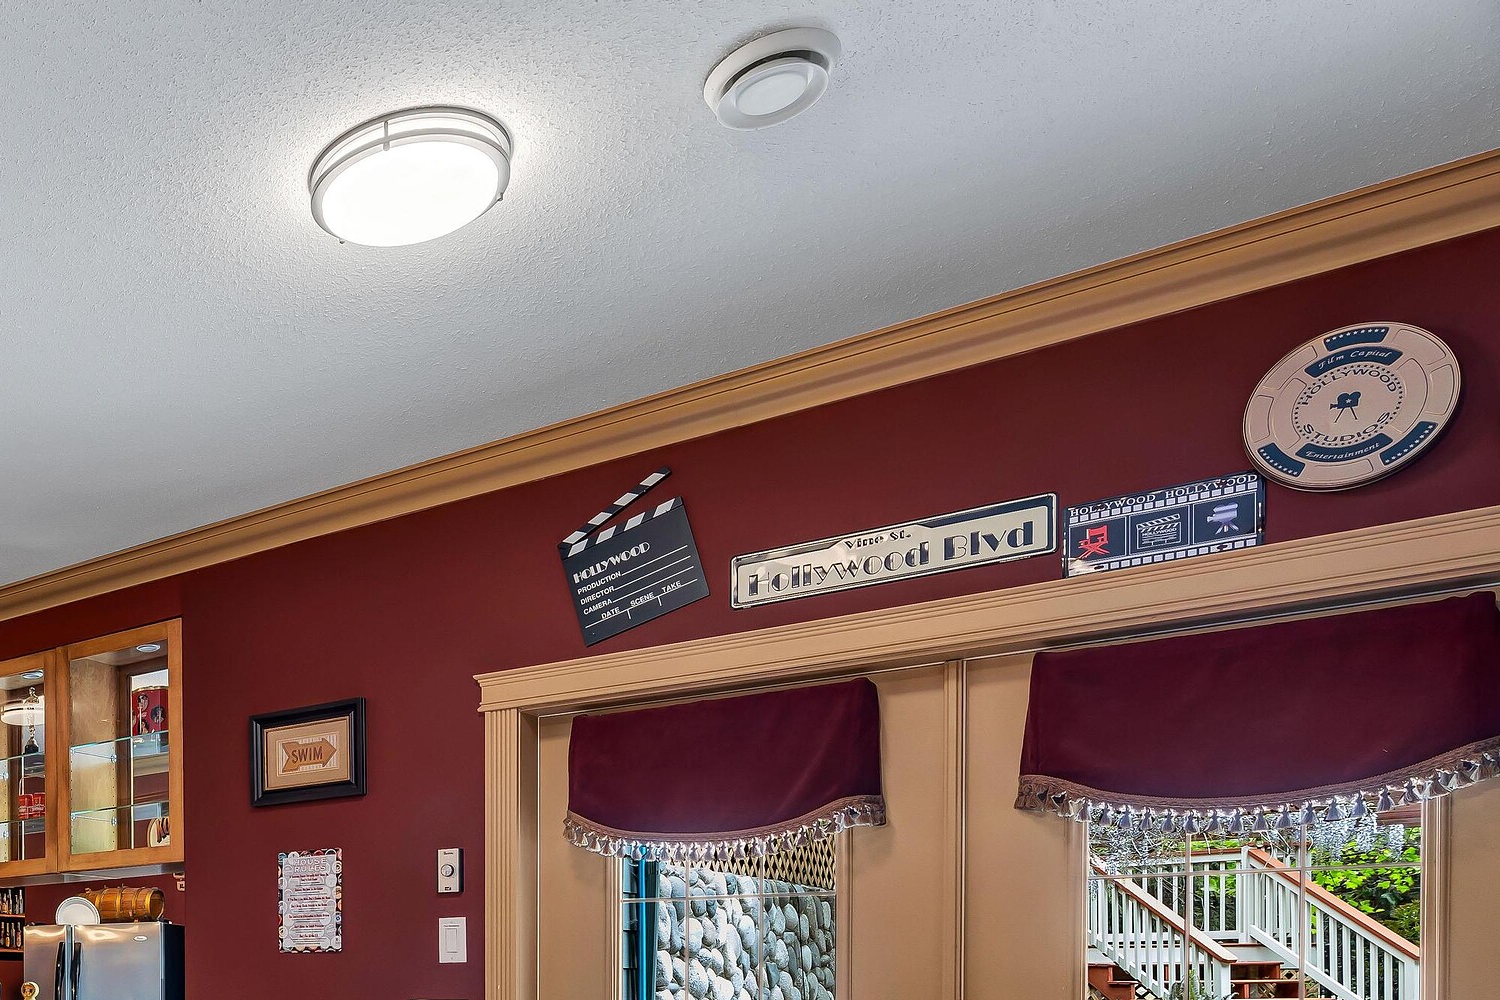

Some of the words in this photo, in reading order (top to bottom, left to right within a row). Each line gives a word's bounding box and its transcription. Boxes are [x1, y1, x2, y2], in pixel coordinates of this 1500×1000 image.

[1319, 355, 1344, 370] Film
[1350, 350, 1392, 358] Capital
[1300, 368, 1397, 406] HOLLYWOOD
[1303, 412, 1390, 442] STUDIOS
[1305, 442, 1381, 460] Entertainment
[572, 541, 651, 584] HOLLYWOOD
[749, 541, 930, 597] Hollywood
[943, 521, 1034, 561] Blvd
[577, 571, 621, 595] PRODUCTION
[580, 585, 615, 605] DIRECTOR
[583, 598, 613, 615] CAMERA
[601, 606, 621, 620] DATE
[630, 592, 655, 607] SCENE
[661, 580, 682, 593] TAKE
[291, 746, 323, 764] SWIM
